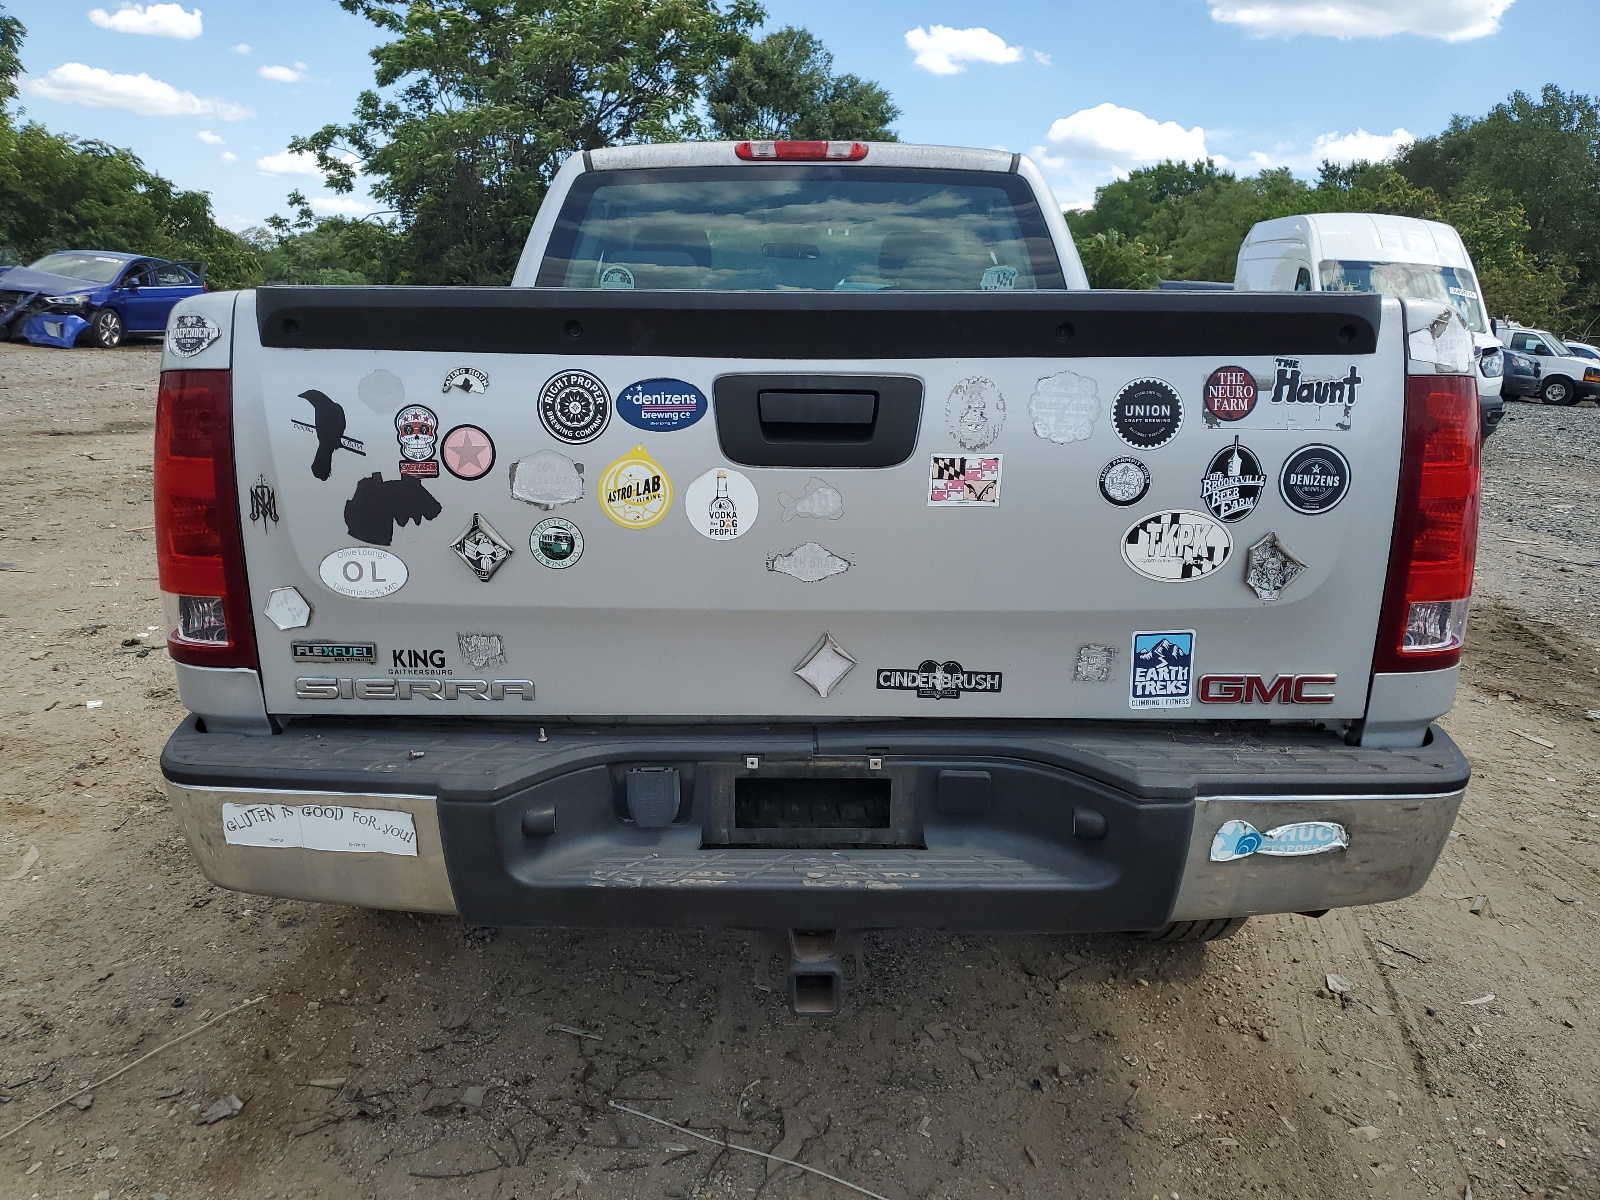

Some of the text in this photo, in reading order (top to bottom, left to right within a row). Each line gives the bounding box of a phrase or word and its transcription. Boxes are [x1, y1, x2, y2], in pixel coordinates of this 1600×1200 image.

[1276, 358, 1299, 368] THE
[444, 369, 488, 391] AYING HOUN
[1218, 373, 1244, 385] THE
[1271, 366, 1361, 404] Haunt
[545, 376, 604, 404] RIGHT PROPER
[1209, 386, 1254, 398] NEURO
[633, 392, 697, 405] denizens
[1214, 399, 1249, 411] FARM
[641, 410, 678, 421] brewing
[1125, 405, 1171, 416] UNION
[547, 411, 603, 437] BREWING COMPANY
[401, 463, 437, 471] 3 STARS
[1210, 471, 1225, 481] THE
[1290, 473, 1340, 487] DENIZENS
[1202, 475, 1266, 498] BROOKEVILLE
[1211, 487, 1240, 509] BEER
[709, 511, 738, 519] VODKA
[1220, 497, 1254, 519] FARM
[533, 519, 574, 538] STREETCAR
[709, 528, 738, 536] PEOPLE
[1146, 523, 1214, 557] TKPK
[337, 548, 387, 560] Olive Lounge
[533, 548, 568, 567] BREWING
[332, 581, 364, 596] Takoma
[384, 582, 399, 593] MD
[296, 646, 372, 657] FLEXFUEL
[392, 649, 446, 669] KING
[878, 670, 1000, 690] CINDERBRUSH
[1134, 665, 1189, 682] EARTH
[295, 677, 535, 701] SIERRA
[1134, 680, 1188, 696] TREKS
[1198, 673, 1337, 704] GMC
[1131, 698, 1190, 707] CLIMBING FITNESS
[226, 806, 277, 832] GLUTEN
[301, 806, 344, 821] GOOD
[352, 811, 381, 831] FOR
